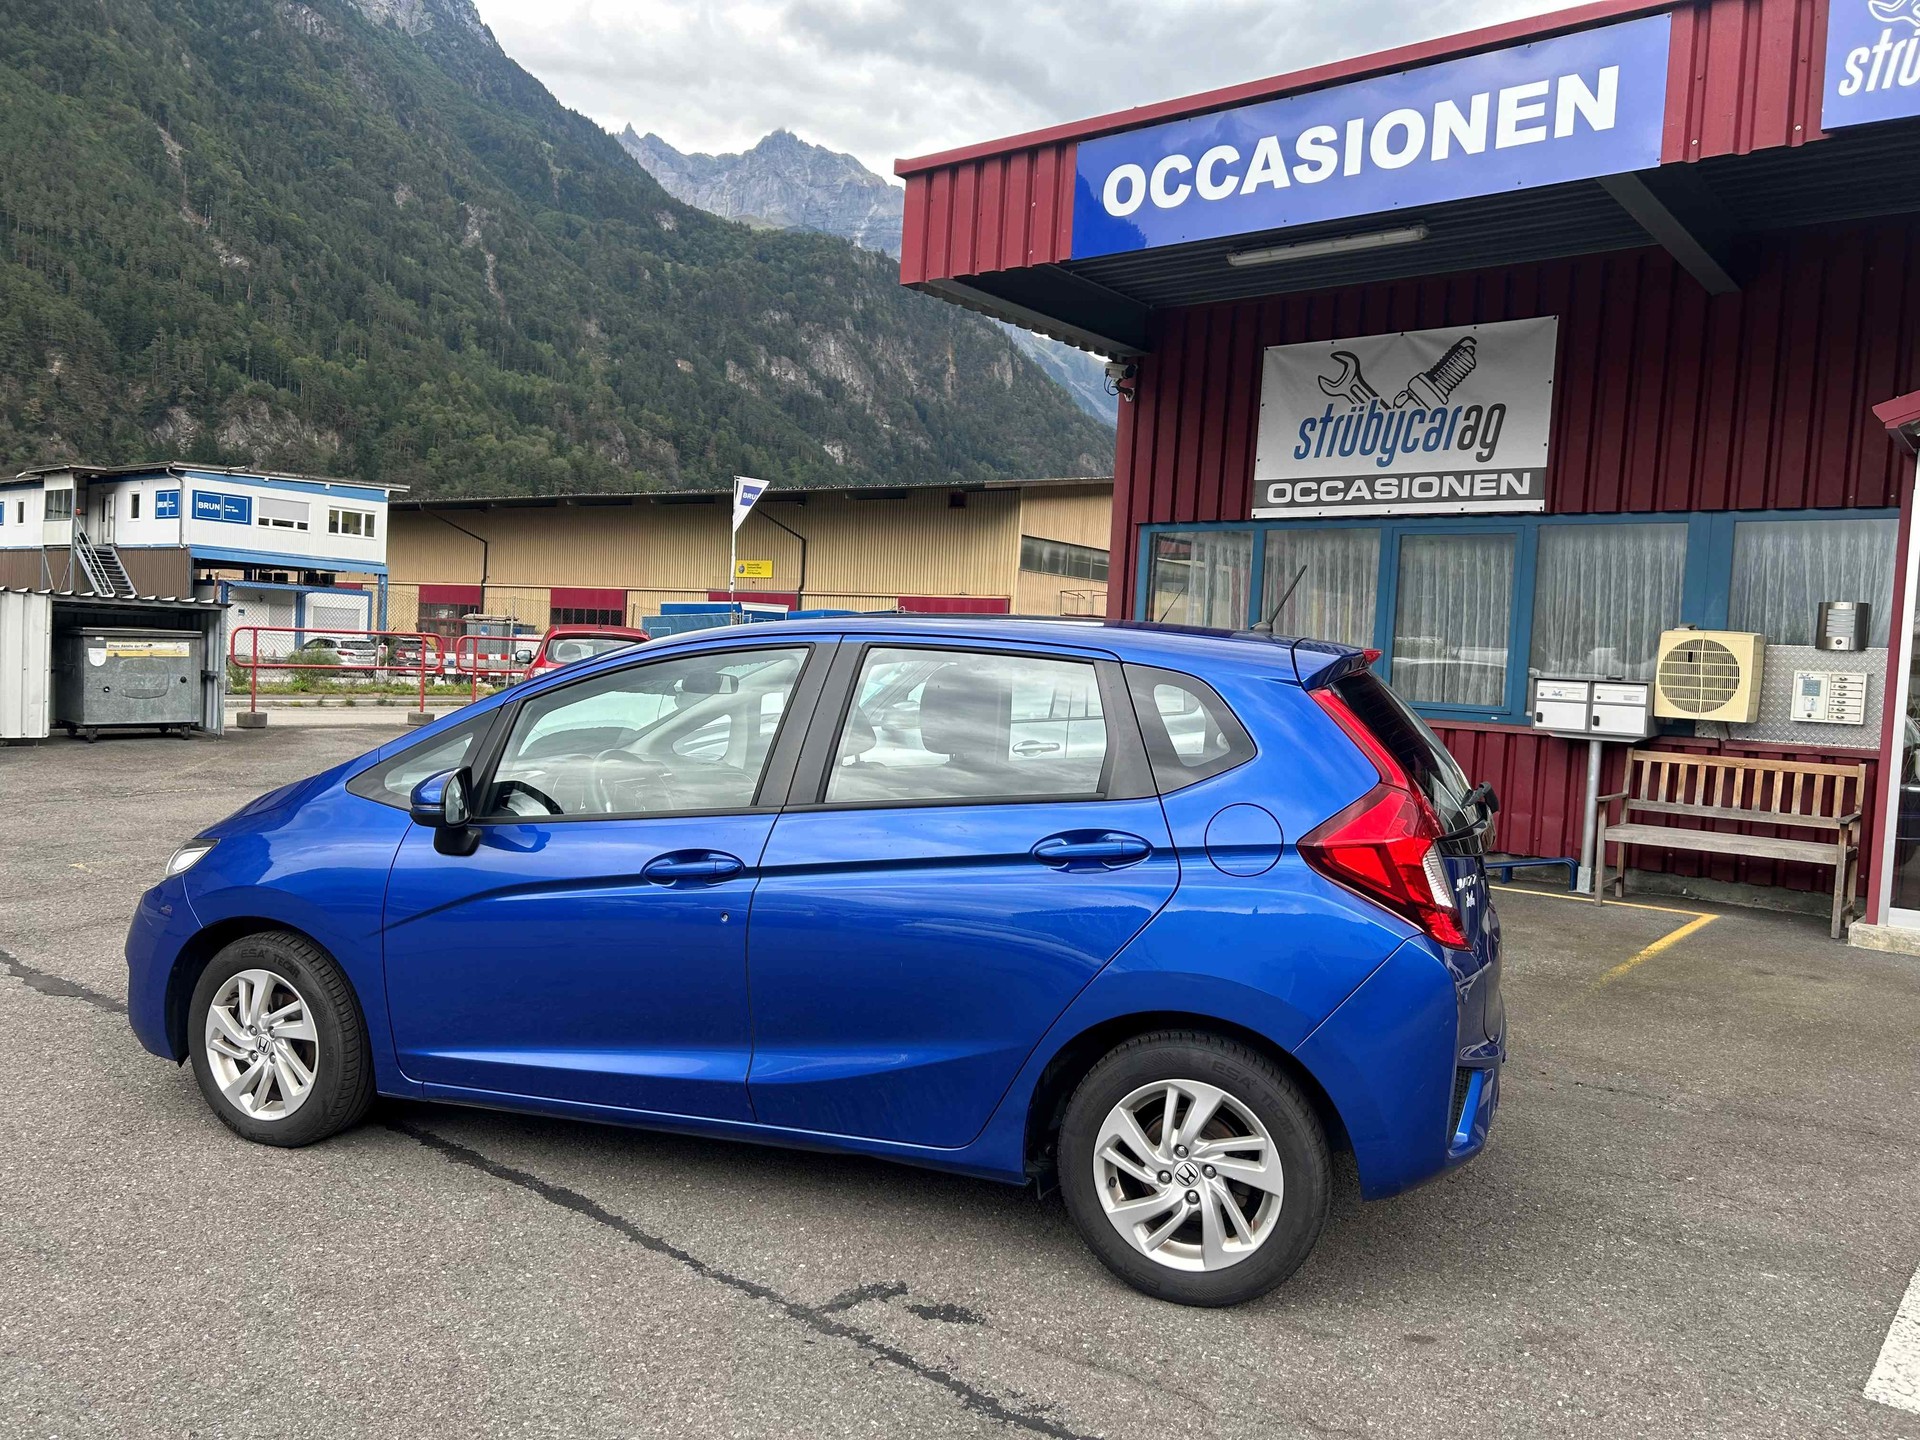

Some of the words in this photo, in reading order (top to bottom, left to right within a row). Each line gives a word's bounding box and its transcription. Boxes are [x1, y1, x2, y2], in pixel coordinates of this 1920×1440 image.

[1102, 65, 1620, 219] OCCASIONEN
[1266, 472, 1531, 504] OCCASIONEN
[198, 501, 221, 511] BRUN
